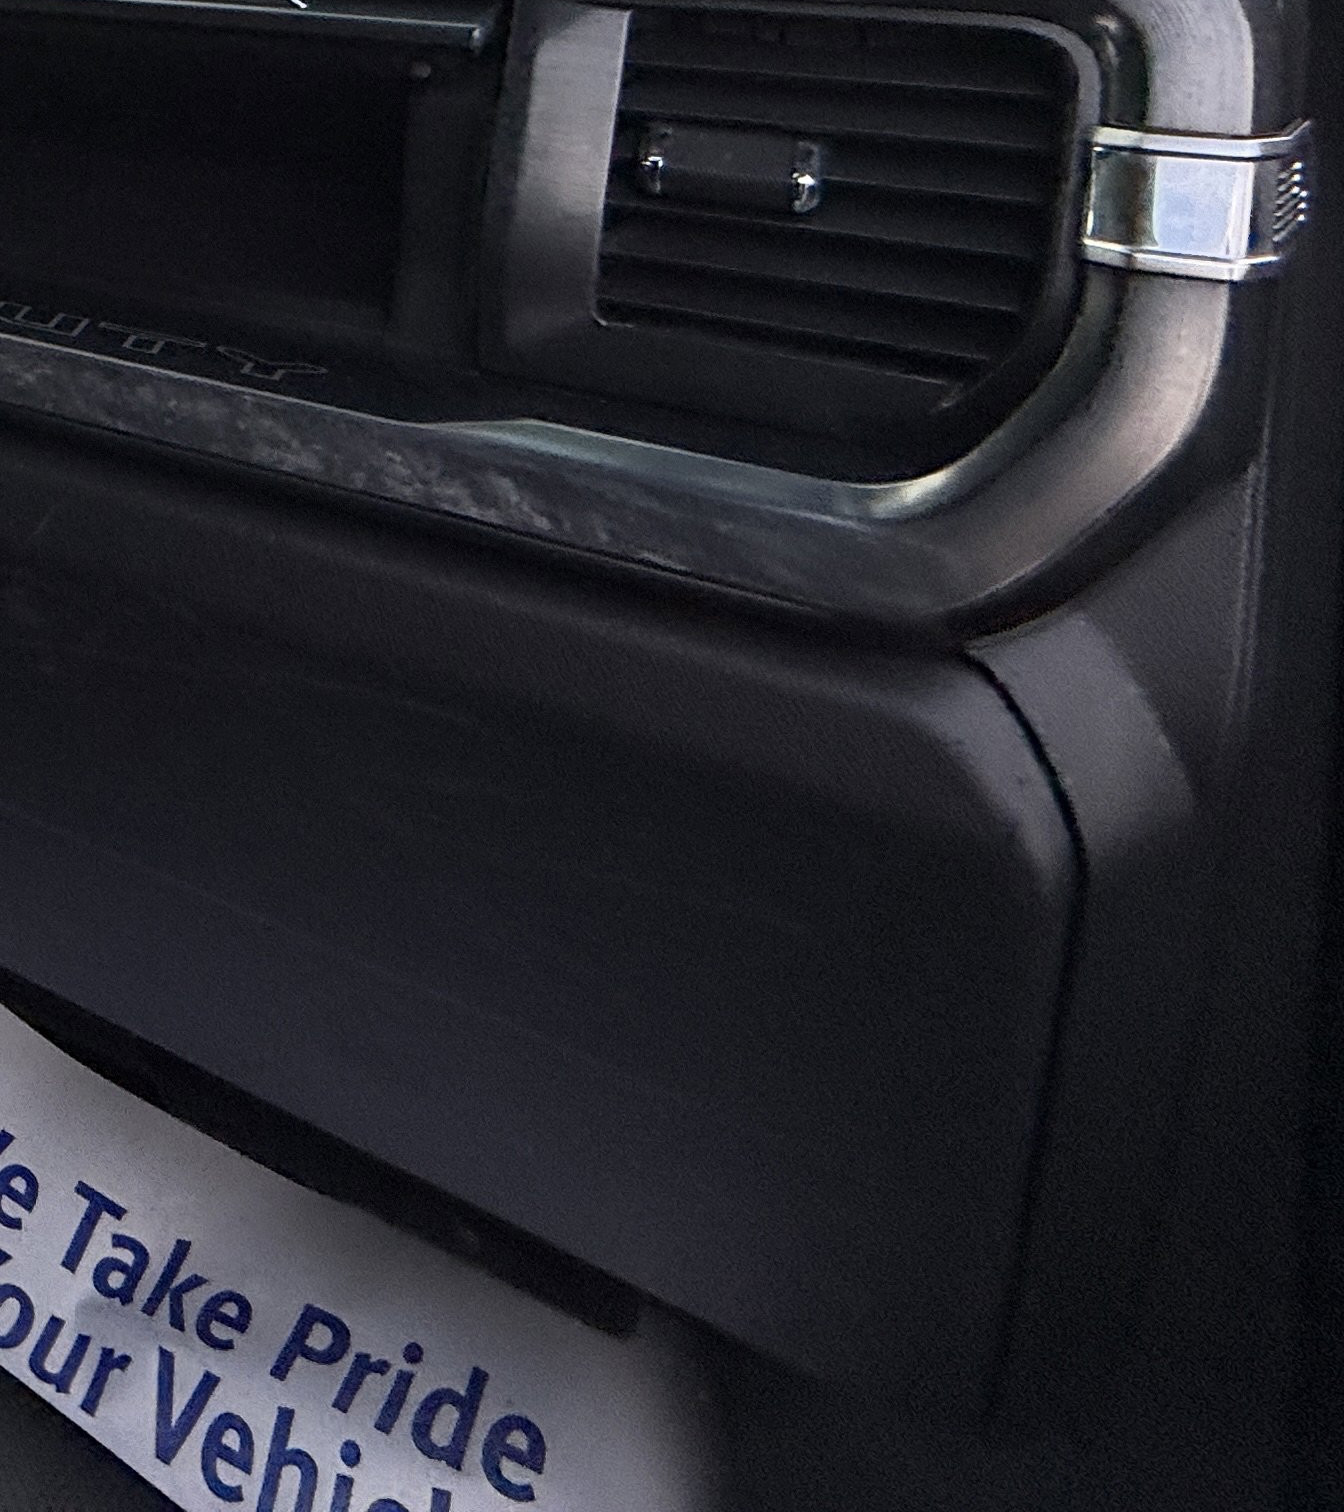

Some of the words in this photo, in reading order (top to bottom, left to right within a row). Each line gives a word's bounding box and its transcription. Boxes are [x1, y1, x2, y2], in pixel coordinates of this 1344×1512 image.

[60, 1180, 254, 1351] Take
[270, 1302, 547, 1502] Pride
[155, 1345, 452, 1512] Vehi
